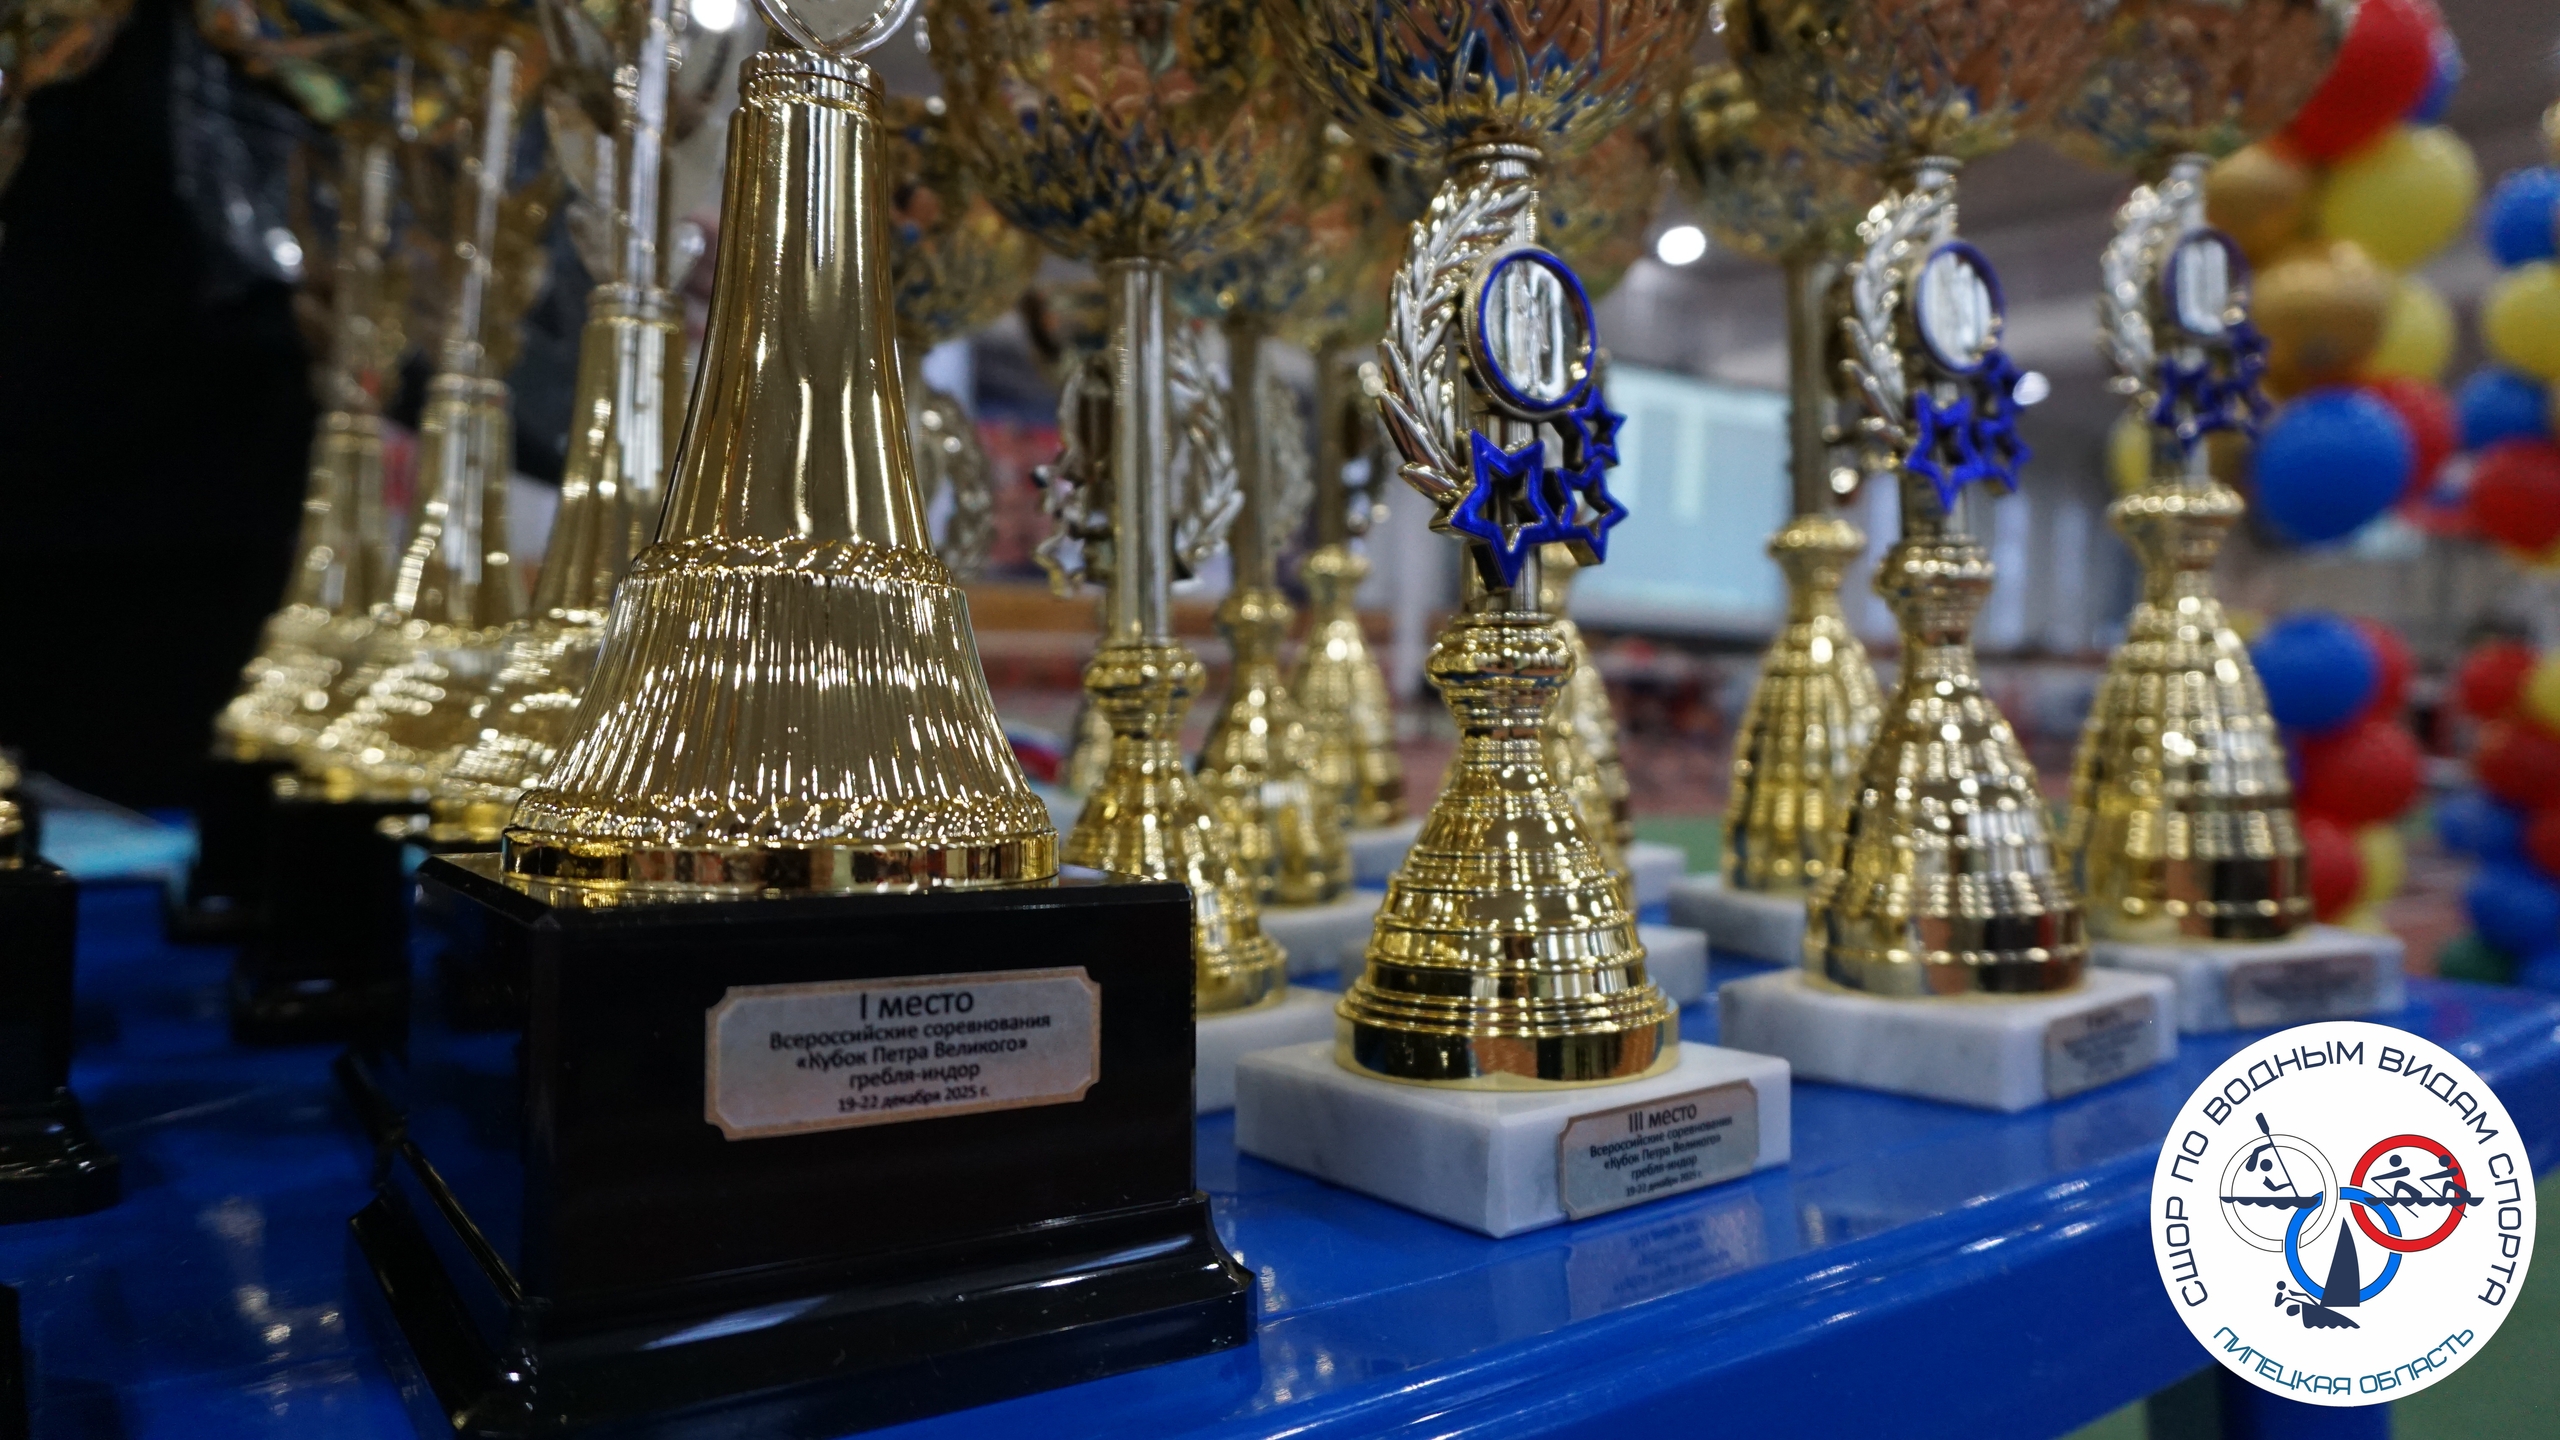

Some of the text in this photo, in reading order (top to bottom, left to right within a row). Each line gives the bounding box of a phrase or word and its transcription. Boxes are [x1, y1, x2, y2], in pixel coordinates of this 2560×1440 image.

[878, 990, 975, 1019] место
[769, 1014, 1051, 1051] Всероссийские соревнования
[796, 1036, 1028, 1072] «Кубок Петра Великого»
[849, 1063, 981, 1090] гребля-индор
[838, 1095, 878, 1113] 19-22
[881, 1089, 940, 1109] декабря
[945, 1084, 977, 1100] 2025
[1649, 1103, 1698, 1128] место
[1590, 1116, 1733, 1158] Всероссийские соревнования
[1604, 1134, 1721, 1170] «Кубок Петра Великого»
[1631, 1154, 1698, 1182] гребля-индор
